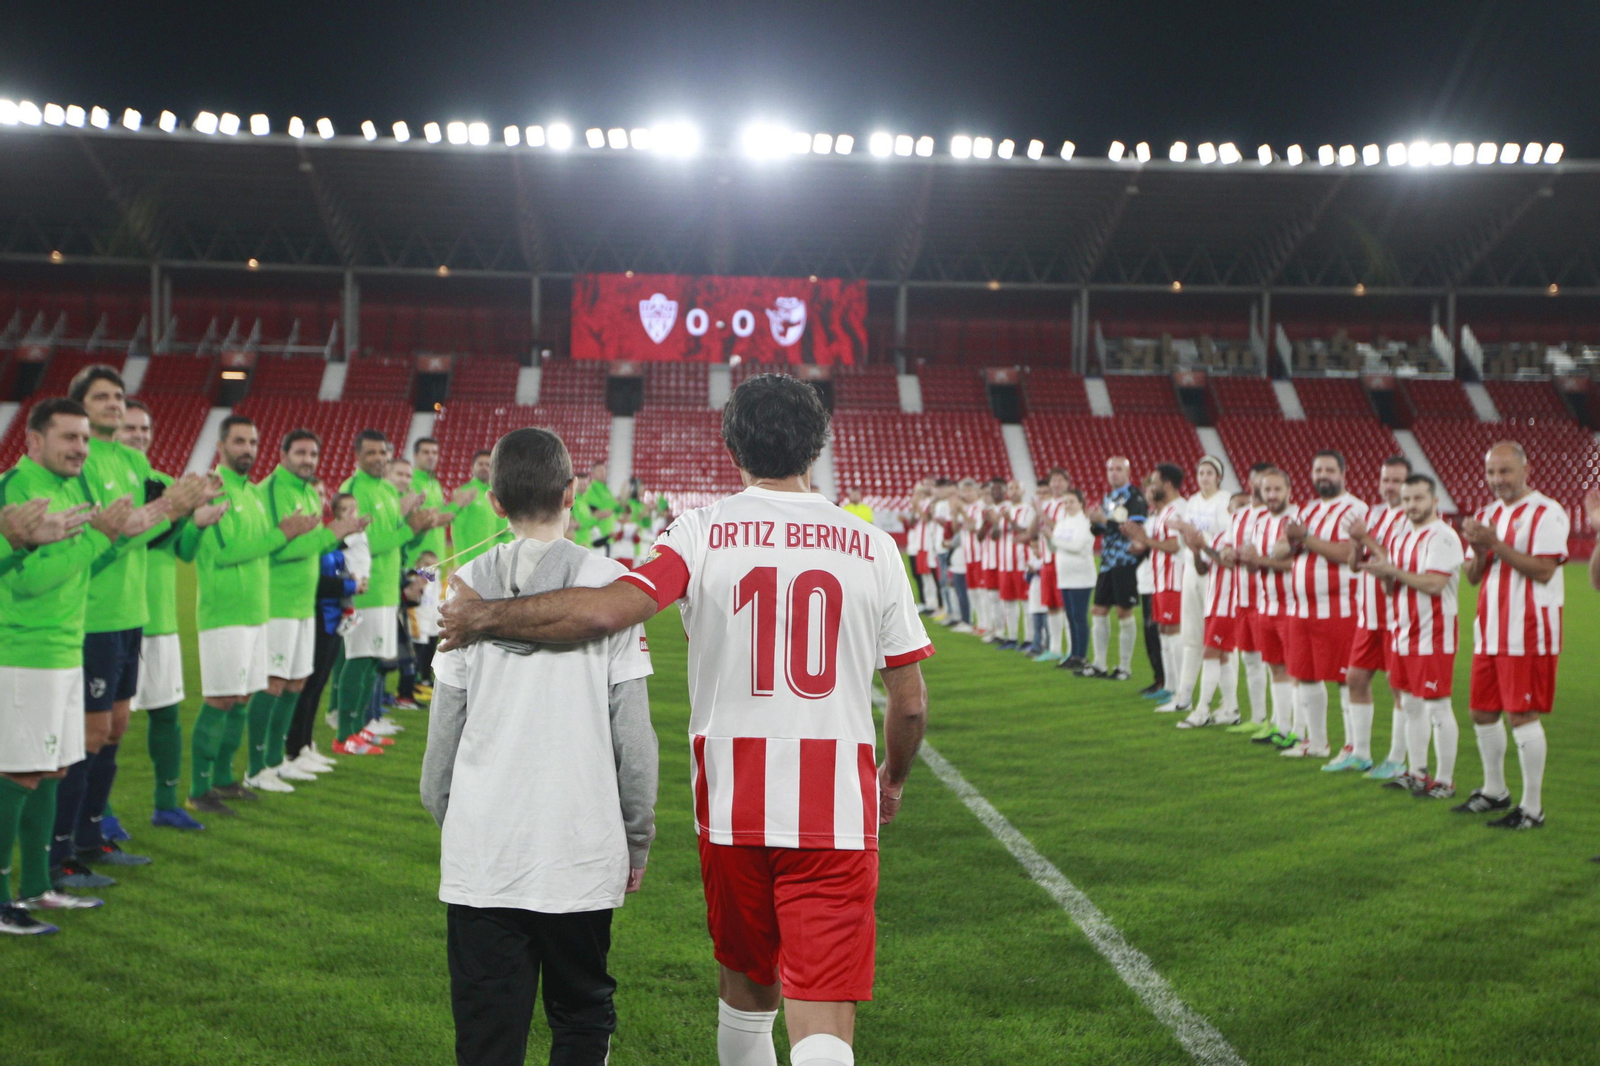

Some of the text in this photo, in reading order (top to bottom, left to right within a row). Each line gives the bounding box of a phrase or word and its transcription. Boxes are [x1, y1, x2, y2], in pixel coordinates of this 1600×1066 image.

[685, 308, 755, 338] 0 0
[708, 520, 875, 563] ORTIZ BERNAL
[733, 566, 843, 700] 10
